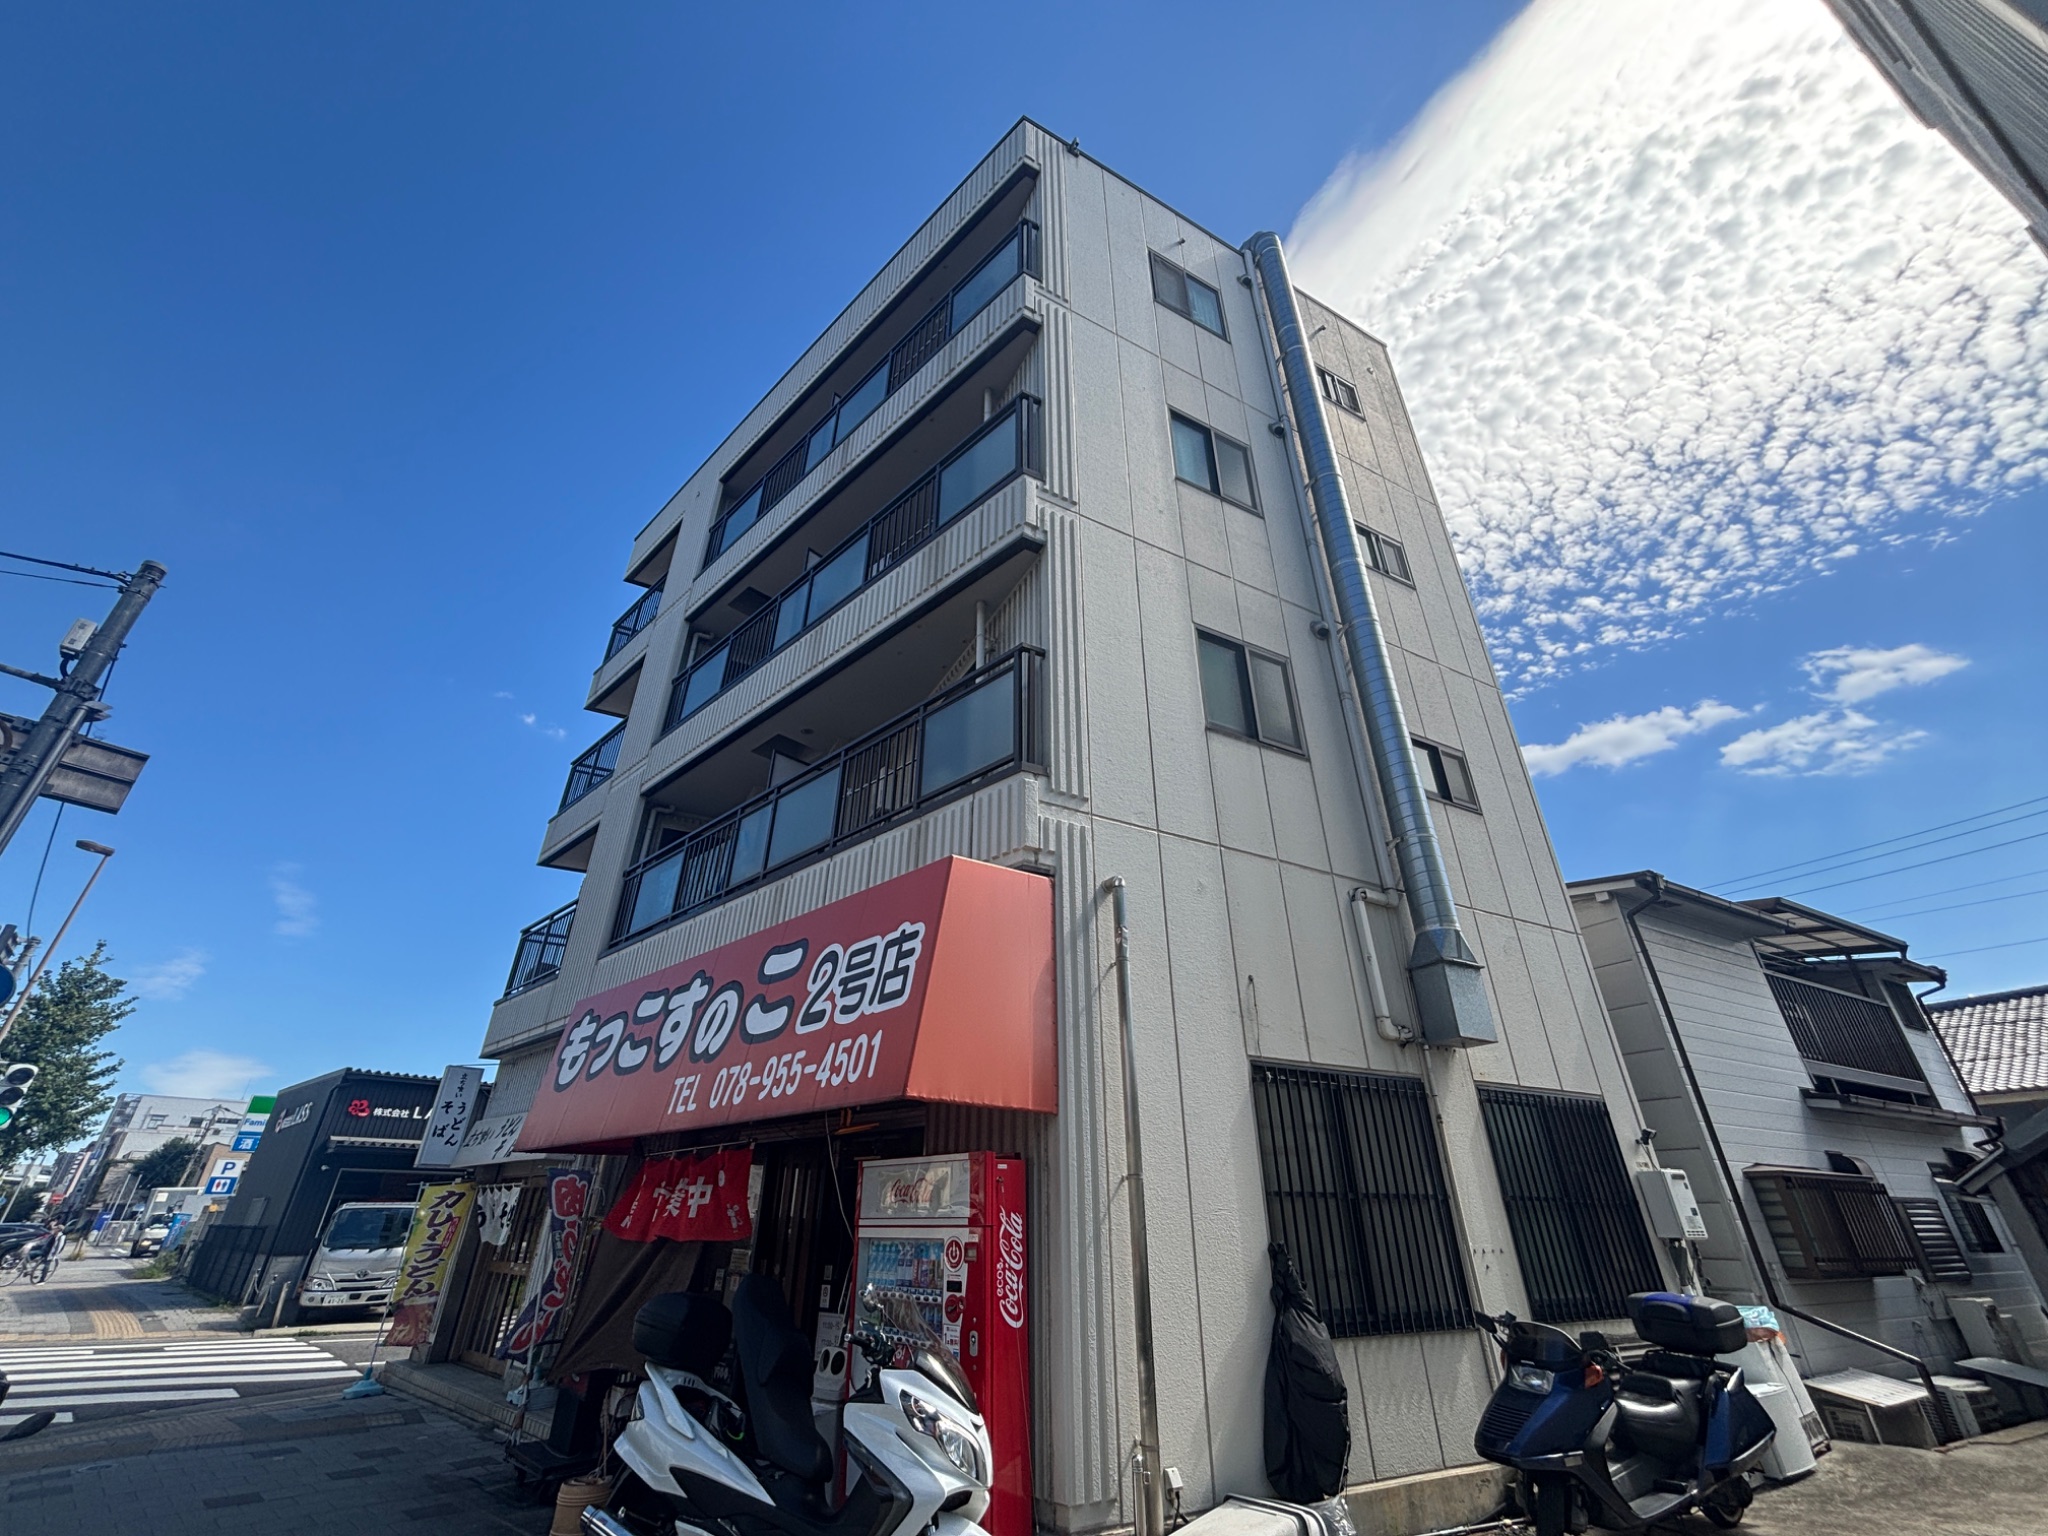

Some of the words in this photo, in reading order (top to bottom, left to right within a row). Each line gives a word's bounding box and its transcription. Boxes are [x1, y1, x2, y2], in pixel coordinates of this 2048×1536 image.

[667, 1073, 703, 1115] TEL
[709, 1029, 883, 1109] 078-955-4501
[373, 1107, 410, 1119] 株式会社
[432, 1101, 454, 1138] そば
[444, 1101, 467, 1147] うどん
[221, 1161, 236, 1175] P
[403, 1190, 467, 1297] カレーうどん
[999, 1205, 1023, 1329] Coca-Cola
